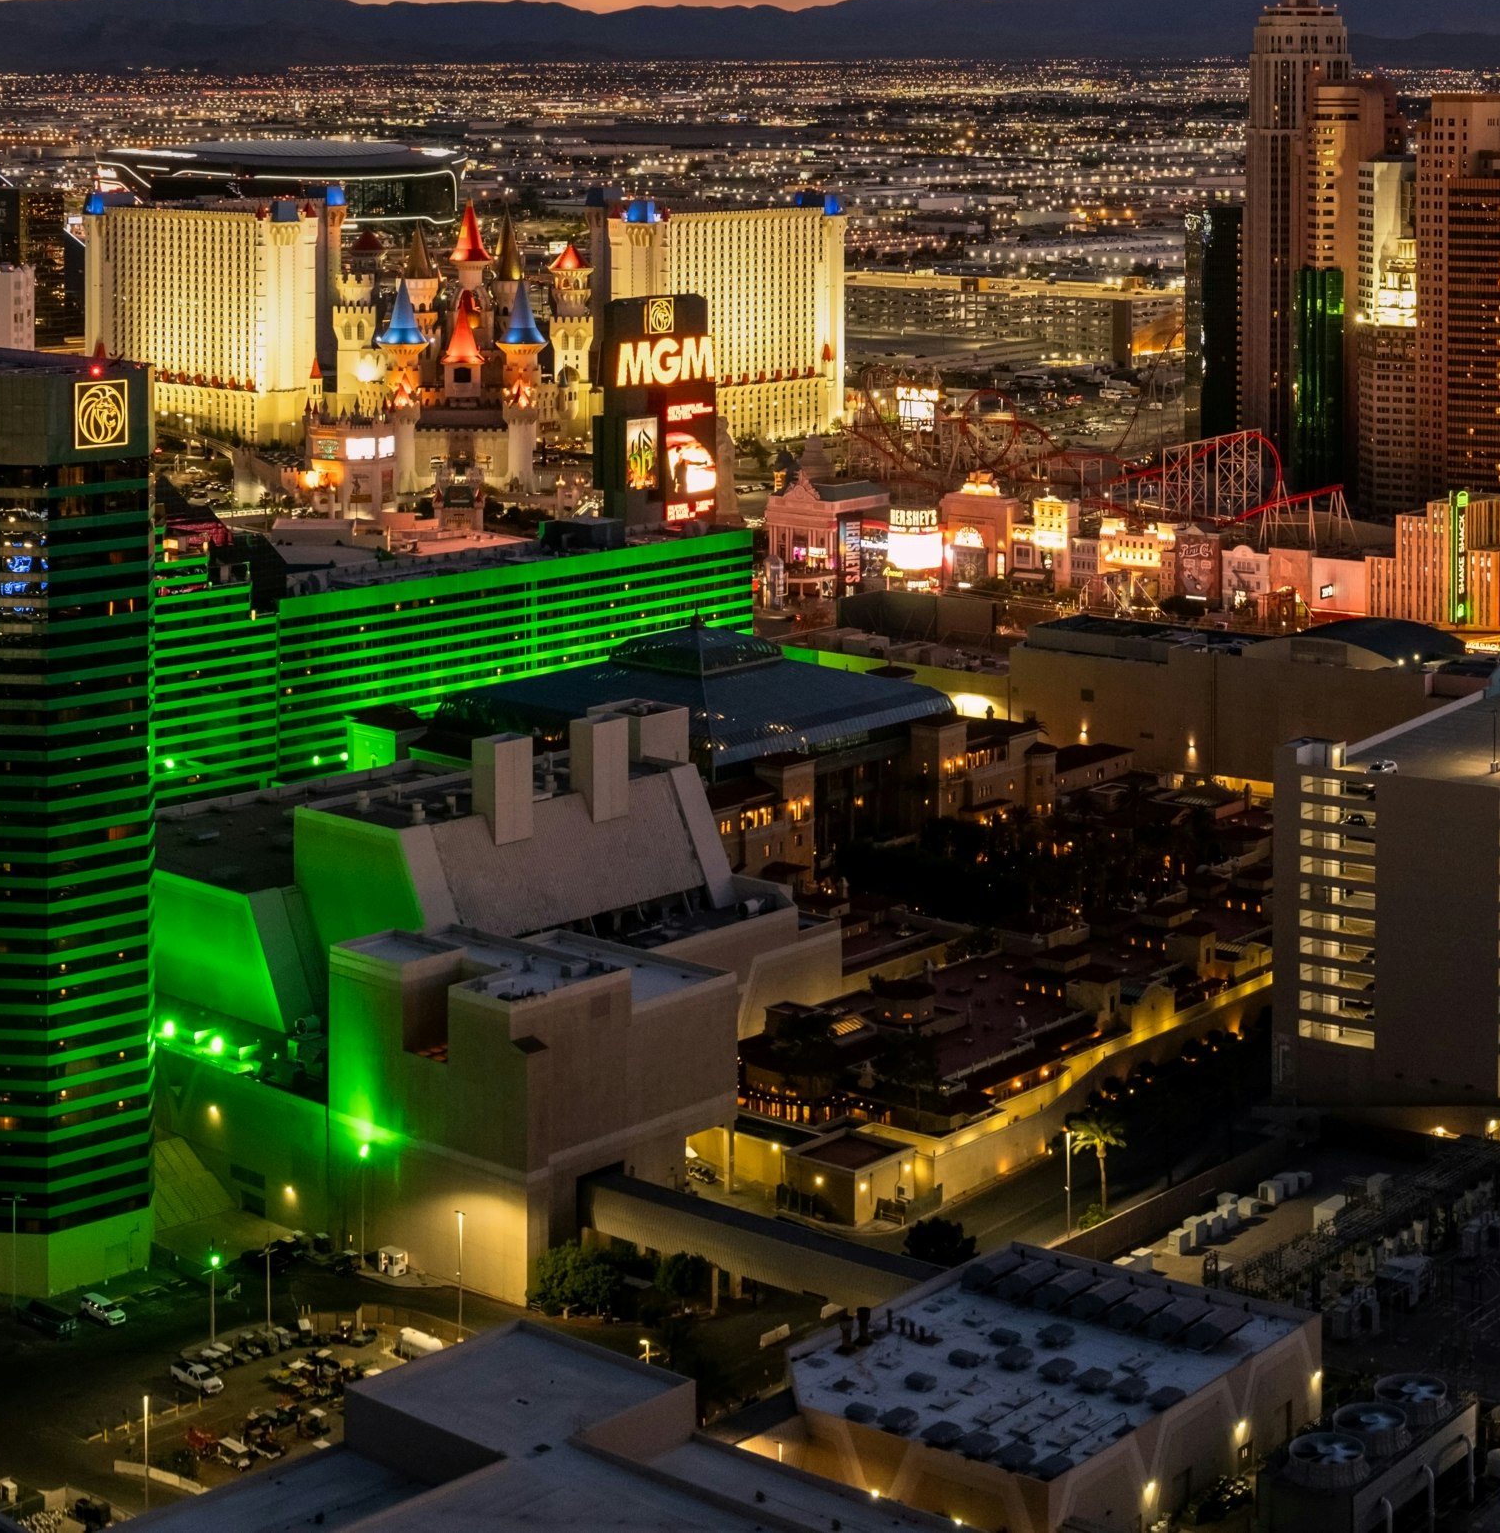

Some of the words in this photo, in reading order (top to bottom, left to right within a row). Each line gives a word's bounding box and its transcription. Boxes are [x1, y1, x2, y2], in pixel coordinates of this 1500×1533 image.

[616, 336, 715, 387] MGM
[890, 509, 937, 526] HERSHEY'S
[1458, 514, 1466, 553] SHACK
[846, 521, 860, 584] HERSHEY'S
[1458, 556, 1466, 594] SHAKE
